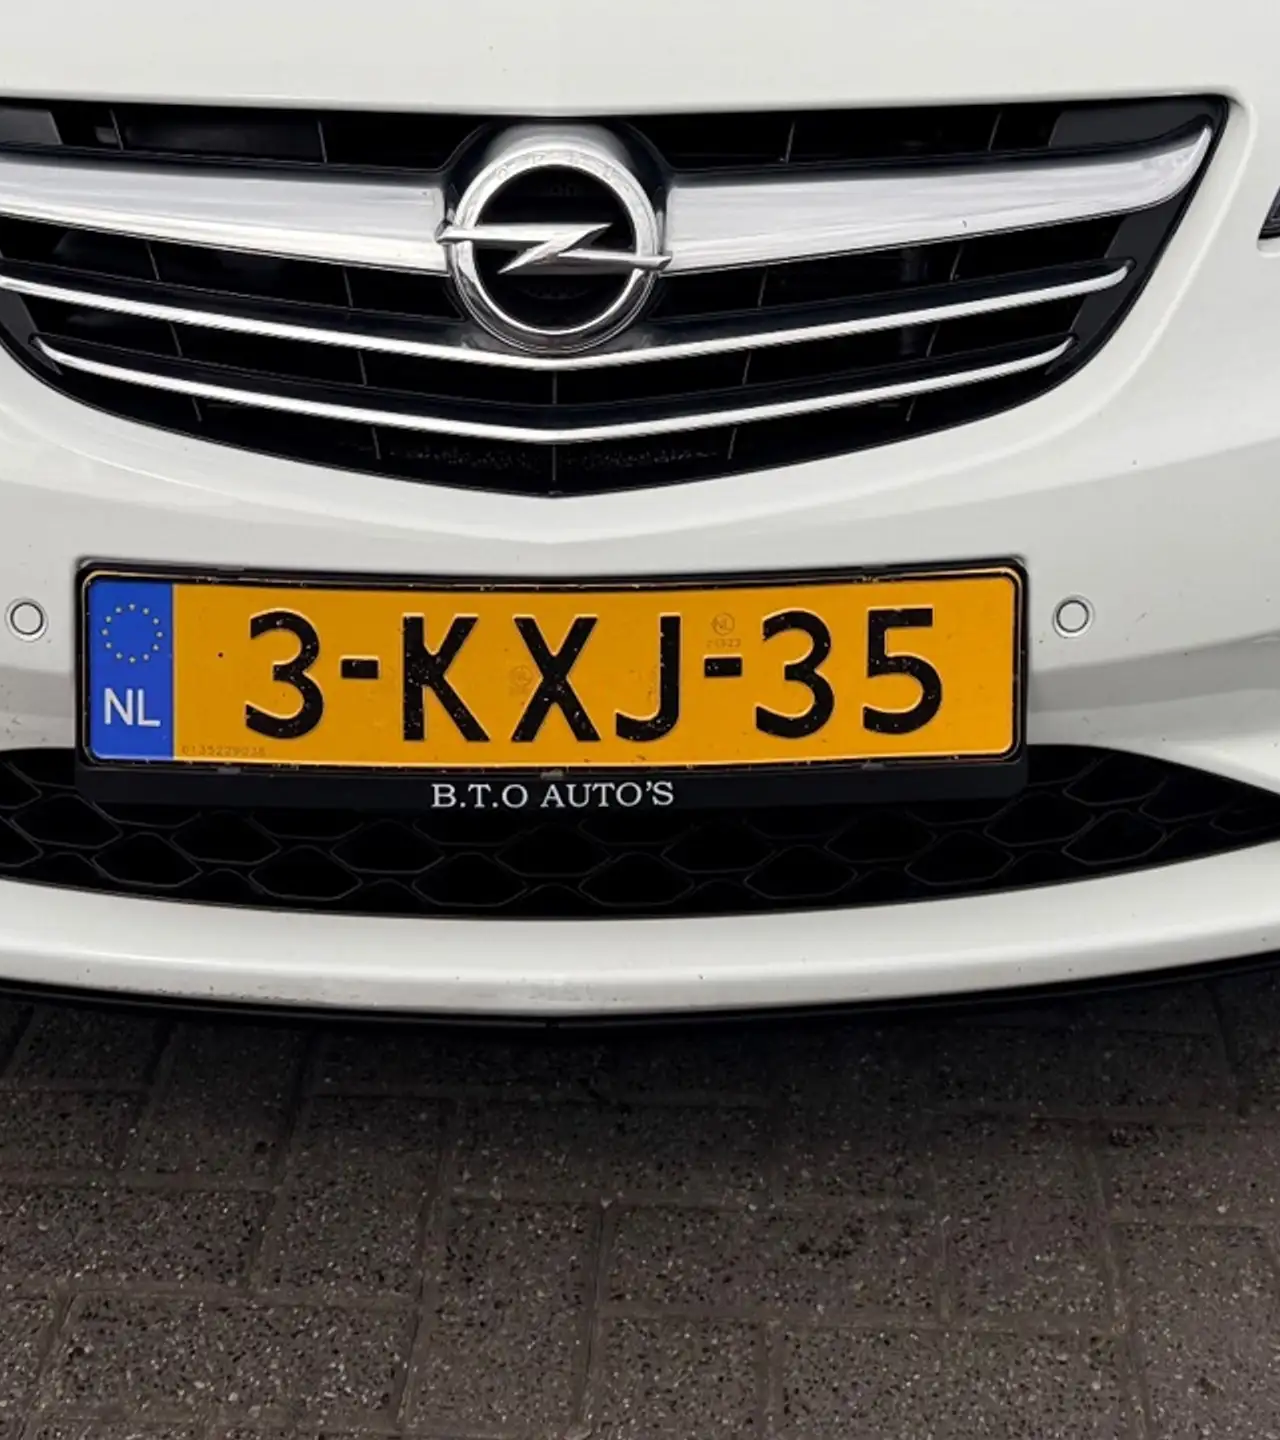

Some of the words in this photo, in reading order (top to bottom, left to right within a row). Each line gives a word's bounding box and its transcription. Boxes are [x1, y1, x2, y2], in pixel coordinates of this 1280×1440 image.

[243, 604, 945, 744] 3-KXJ-35
[103, 687, 161, 728] NL
[431, 783, 529, 808] B.T.O
[540, 781, 674, 807] AUTO'S
